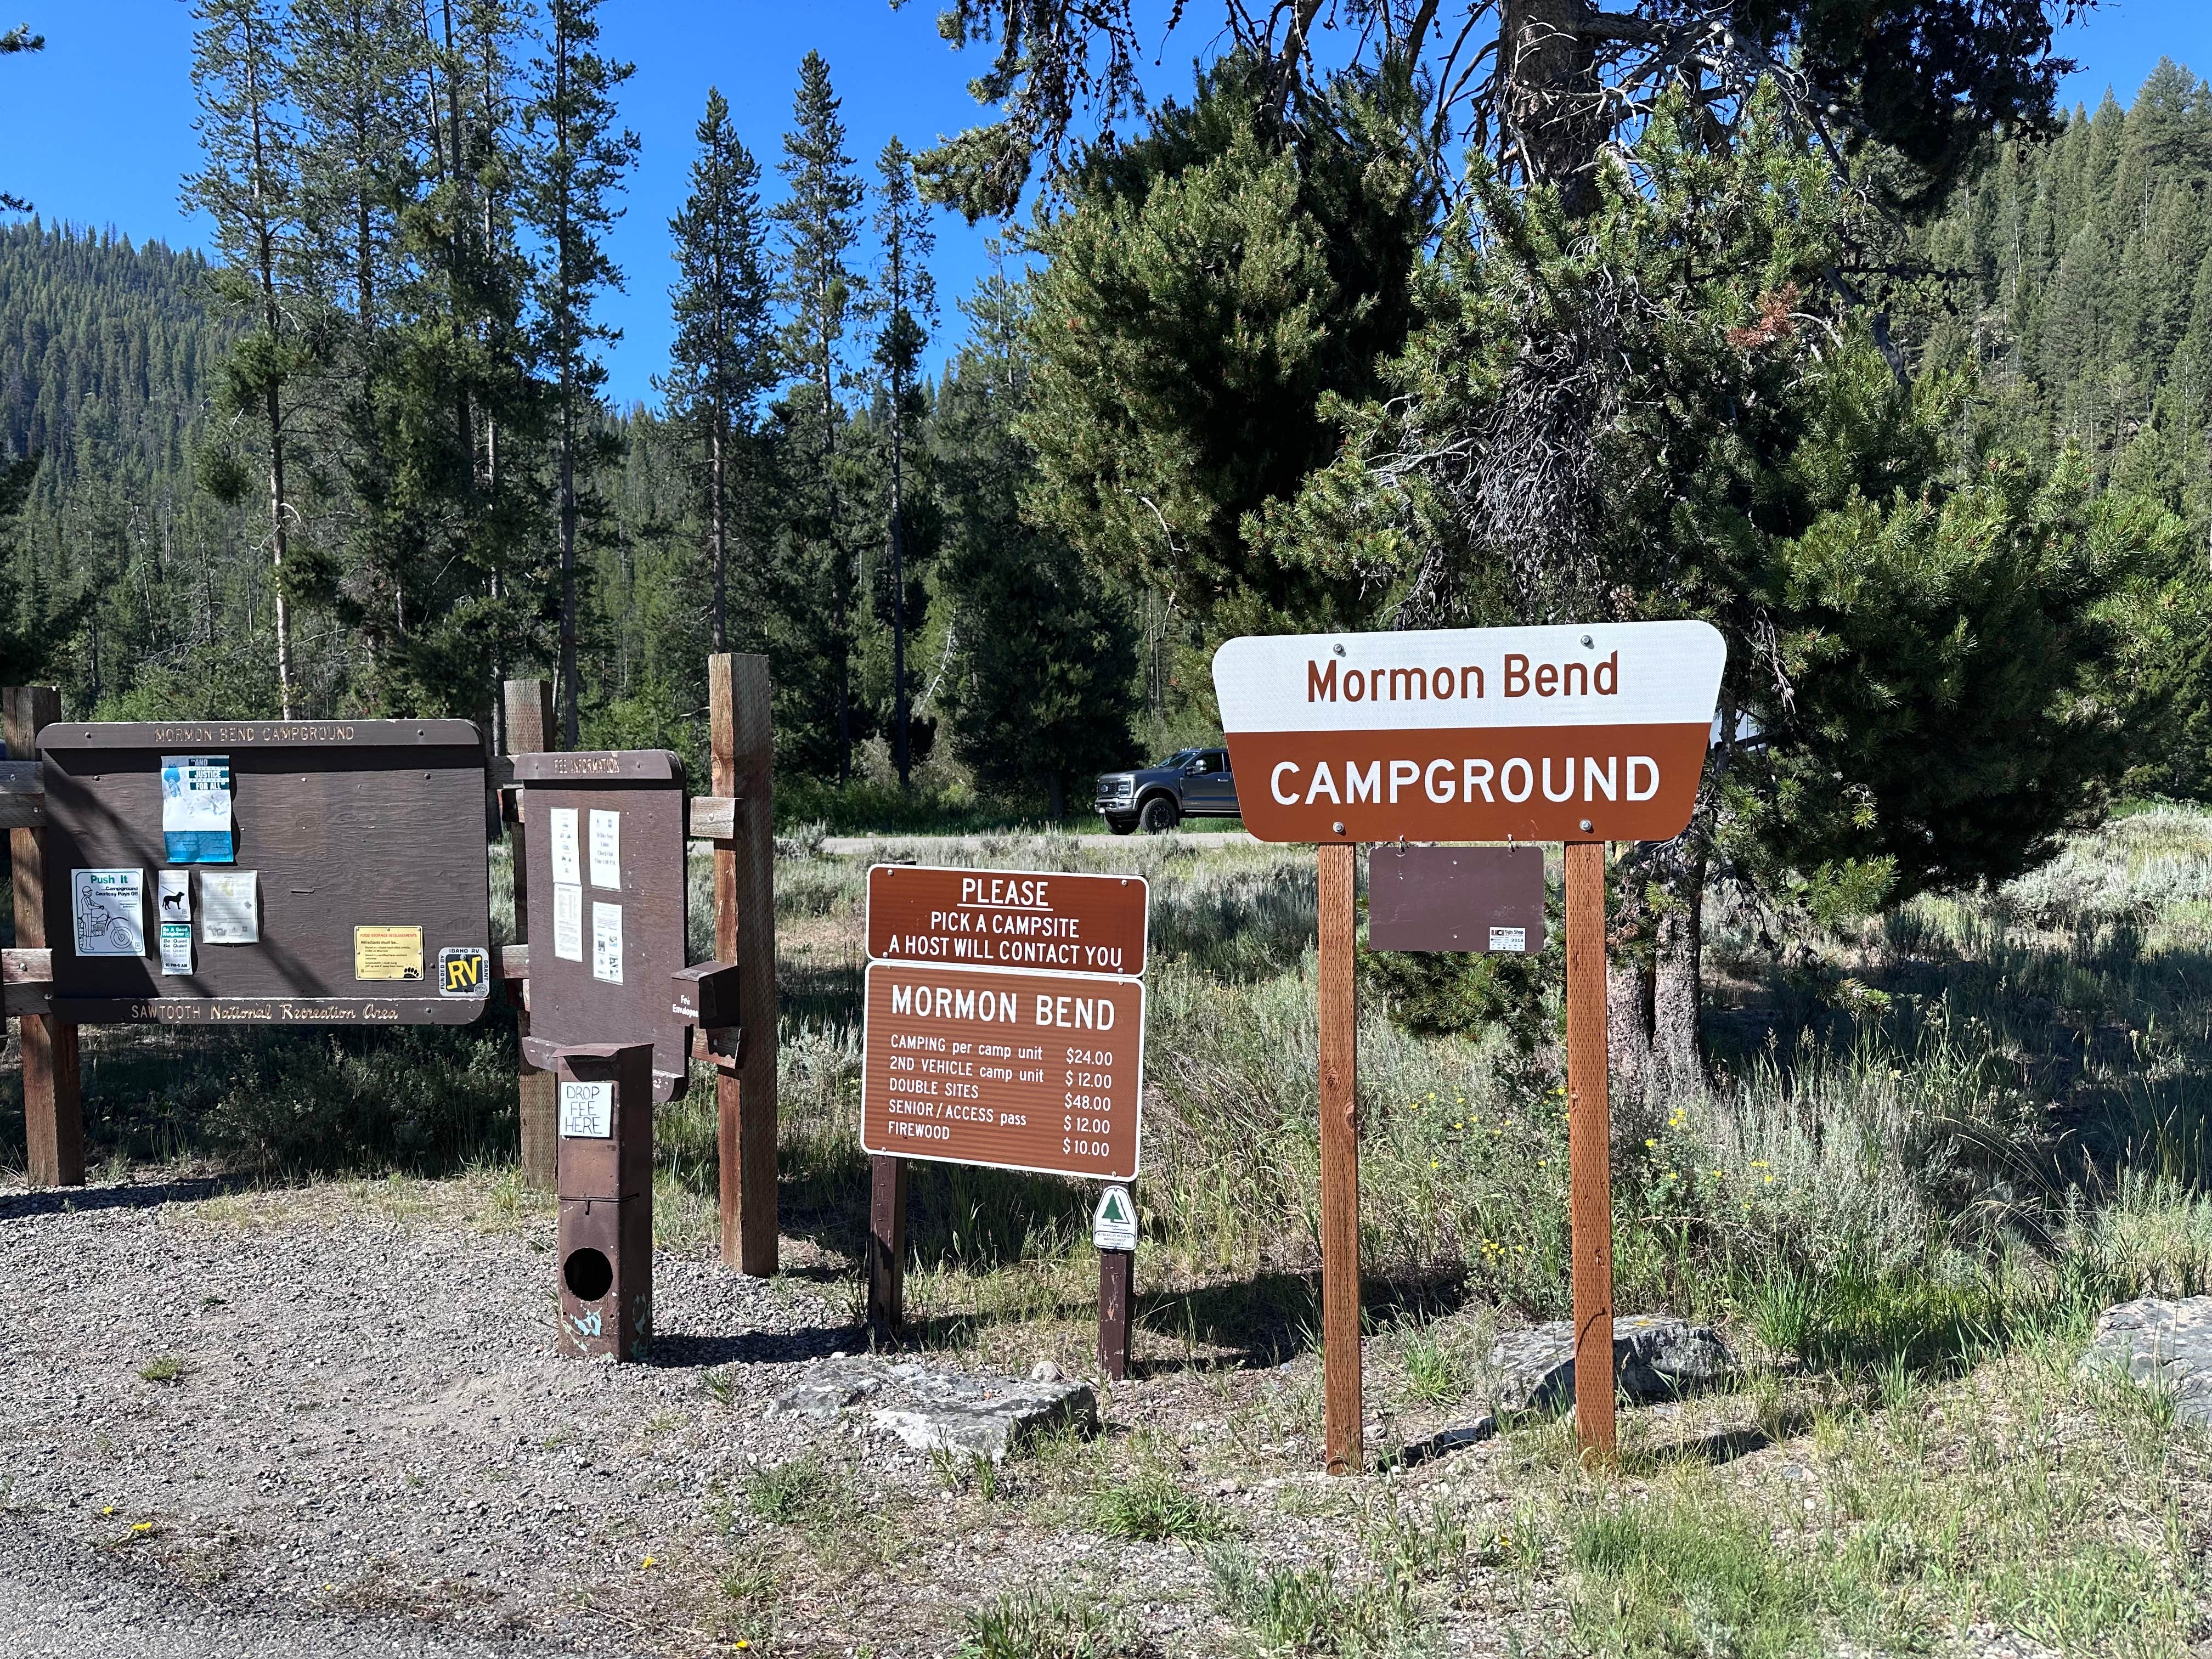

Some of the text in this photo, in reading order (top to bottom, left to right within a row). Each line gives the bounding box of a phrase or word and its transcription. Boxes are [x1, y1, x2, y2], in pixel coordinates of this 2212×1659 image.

[1308, 650, 1617, 703] Mormon Bend
[154, 726, 354, 741] MORMON BEND CAMPGROUND
[554, 758, 620, 774] FEE INFORMATION
[1271, 755, 1660, 805] CAMPGROUND
[91, 875, 128, 884] Push It
[962, 878, 1049, 906] PLEASE
[931, 911, 1080, 938] PICK A CAMPSITE
[889, 935, 1122, 967] A HOST WILL CONTACT YOU
[447, 956, 481, 990] RV
[680, 995, 690, 1005] Fee
[891, 984, 1115, 1031] MORMON BEND
[132, 1002, 398, 1020] SAWTOOTH National Recreation Area
[672, 1004, 699, 1018] Envelopes
[890, 1034, 1113, 1066] CAMPING per camp unit $24.00
[890, 1056, 915, 1071] 2ND
[921, 1058, 973, 1076] VEHICLE
[979, 1066, 1013, 1081] camp
[1019, 1068, 1044, 1083] unit
[567, 1086, 600, 1100] DROP
[889, 1077, 1111, 1111] DOUBLE SITES $48.00
[571, 1101, 597, 1116] FEE
[565, 1116, 602, 1134] HERE
[1000, 1112, 1026, 1126] pass
[888, 1121, 950, 1140] FIREWOOD
